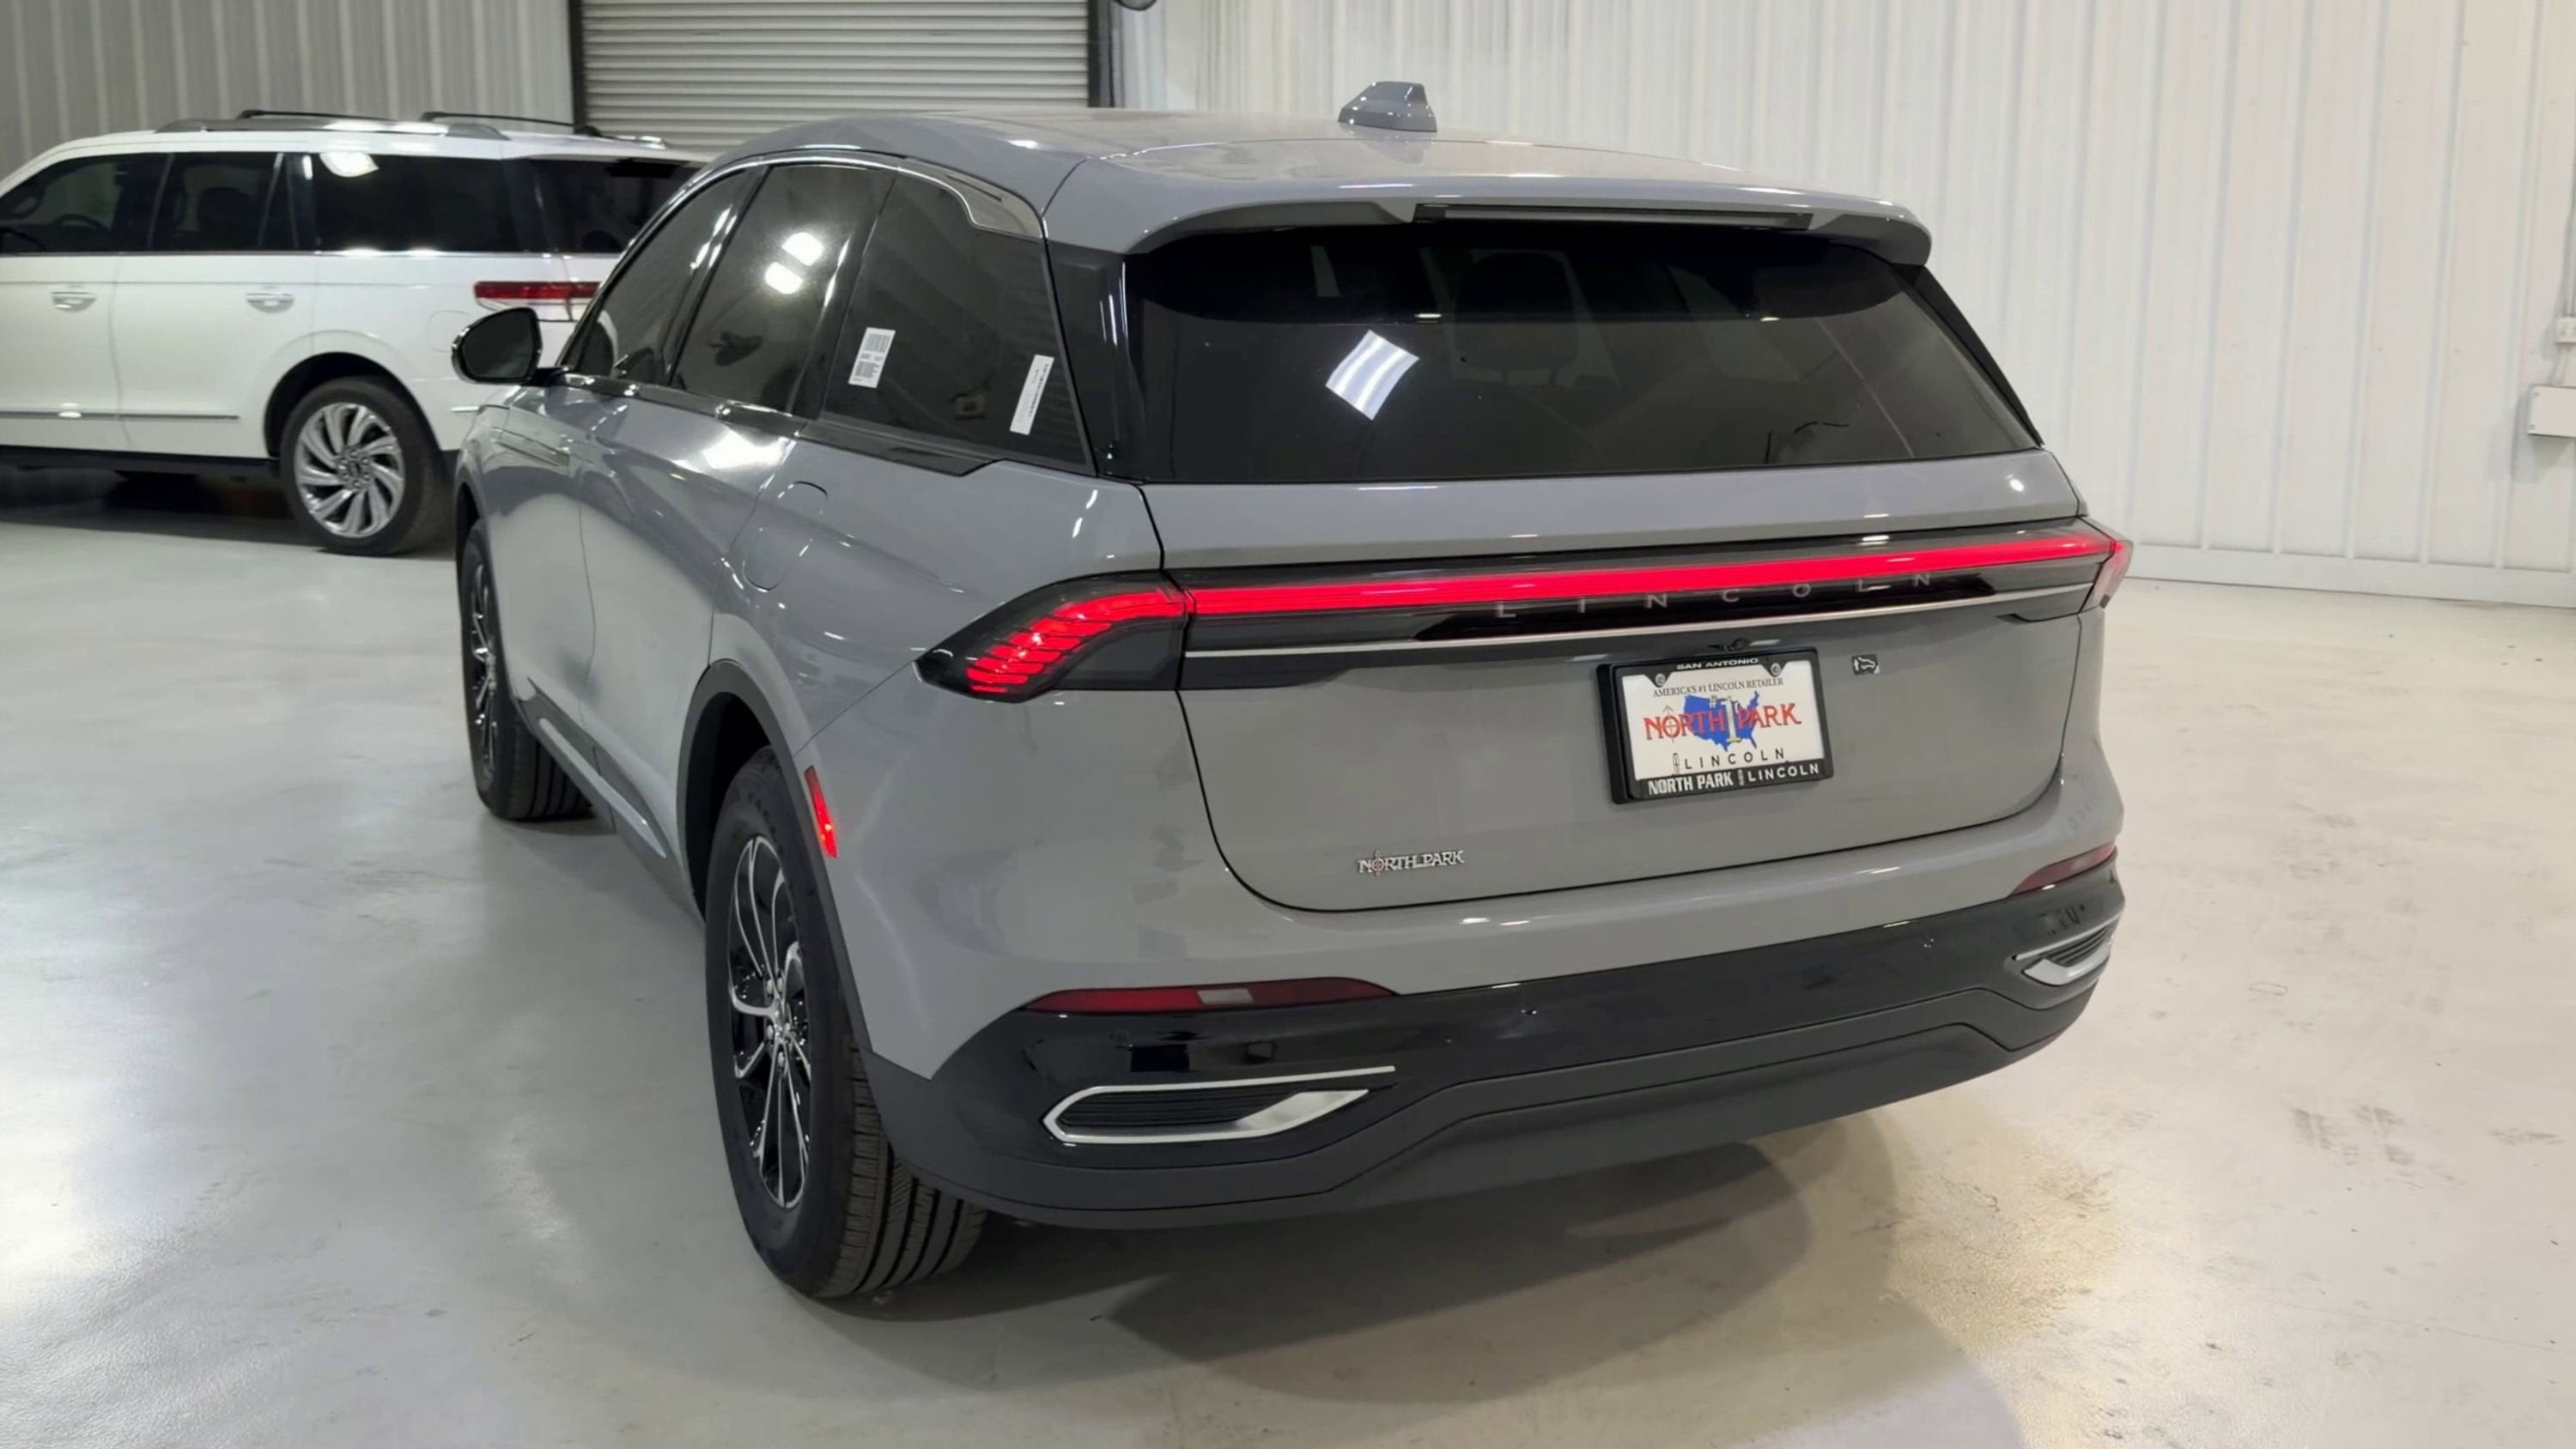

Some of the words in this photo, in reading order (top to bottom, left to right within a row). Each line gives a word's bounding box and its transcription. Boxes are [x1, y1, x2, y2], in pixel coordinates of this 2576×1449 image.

[1495, 573, 1931, 618] LINCOLN
[1705, 658, 1759, 668] ANTONIO
[1653, 687, 1697, 697] AMERICA'S
[1709, 682, 1746, 692] LINCOLN
[1747, 677, 1783, 688] RETAILER
[1643, 710, 1726, 740] NORTH
[1738, 703, 1801, 729] PARK
[1685, 749, 1784, 769] LINCOLN
[1648, 777, 1693, 795] NORTH
[1697, 772, 1734, 789] PARK
[1747, 763, 1819, 782] LINCOLN
[1357, 855, 1417, 873] NORTH
[1421, 851, 1465, 867] PARK
